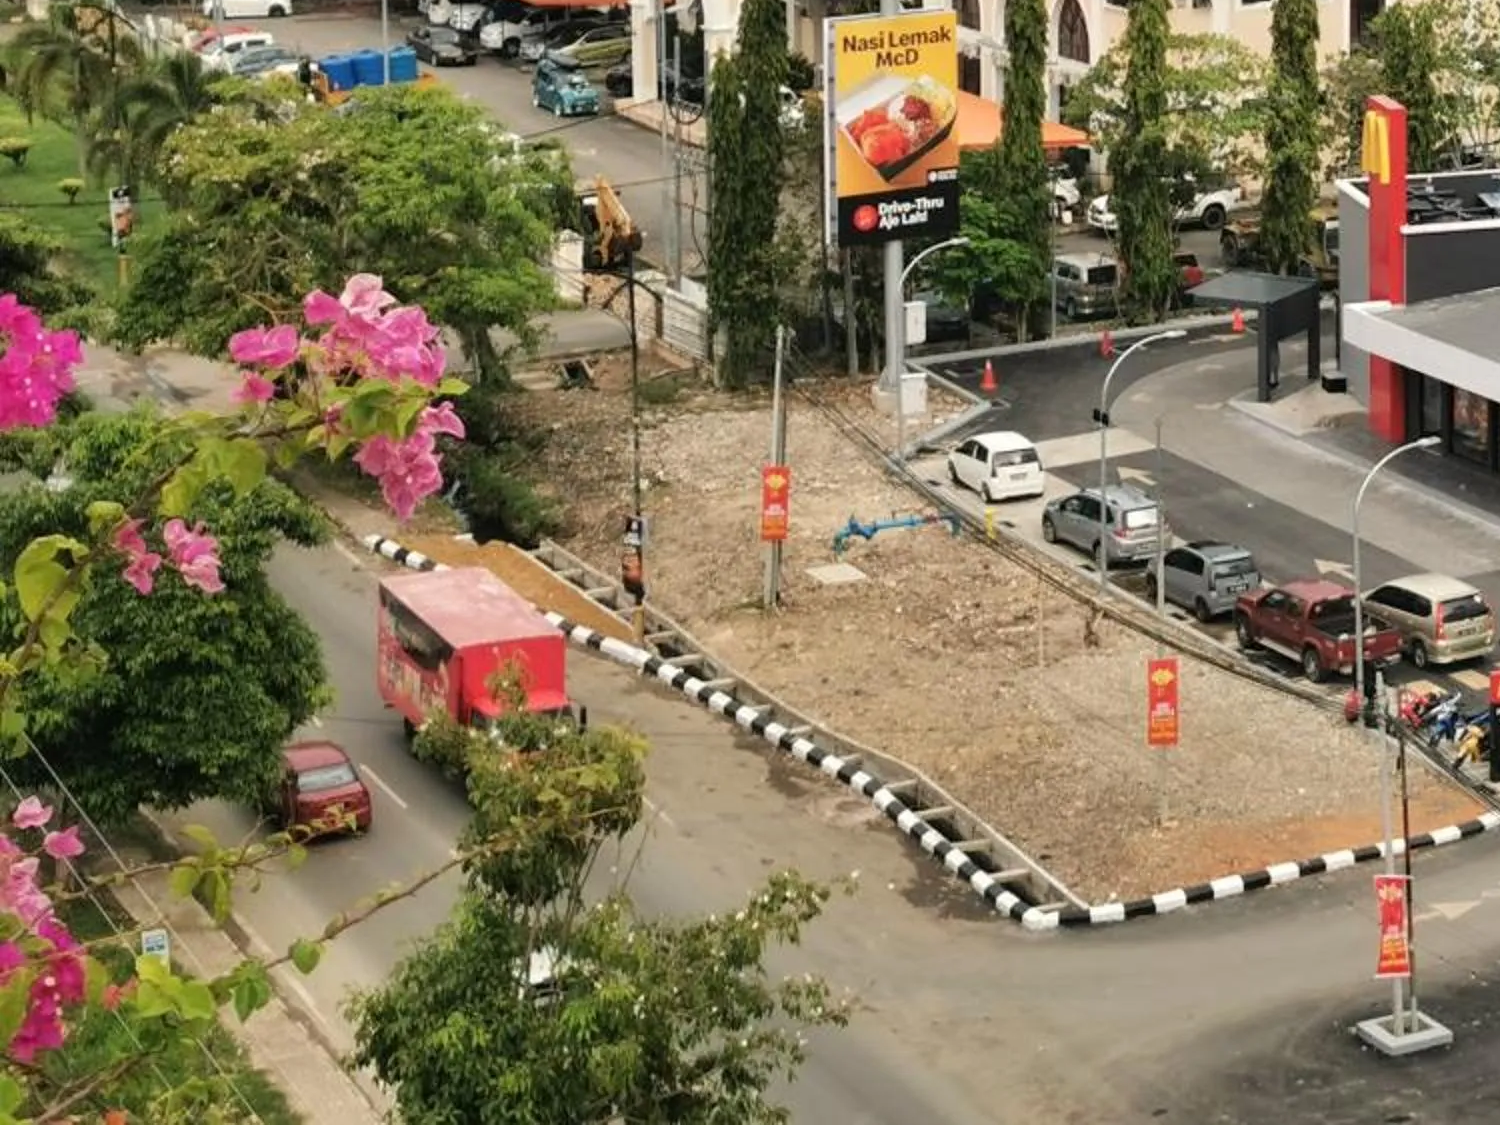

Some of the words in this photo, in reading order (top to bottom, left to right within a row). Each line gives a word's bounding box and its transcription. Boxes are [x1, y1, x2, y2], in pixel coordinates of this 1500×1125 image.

[842, 31, 884, 53] Nasi
[888, 25, 952, 48] Lemak
[876, 48, 919, 68] McD
